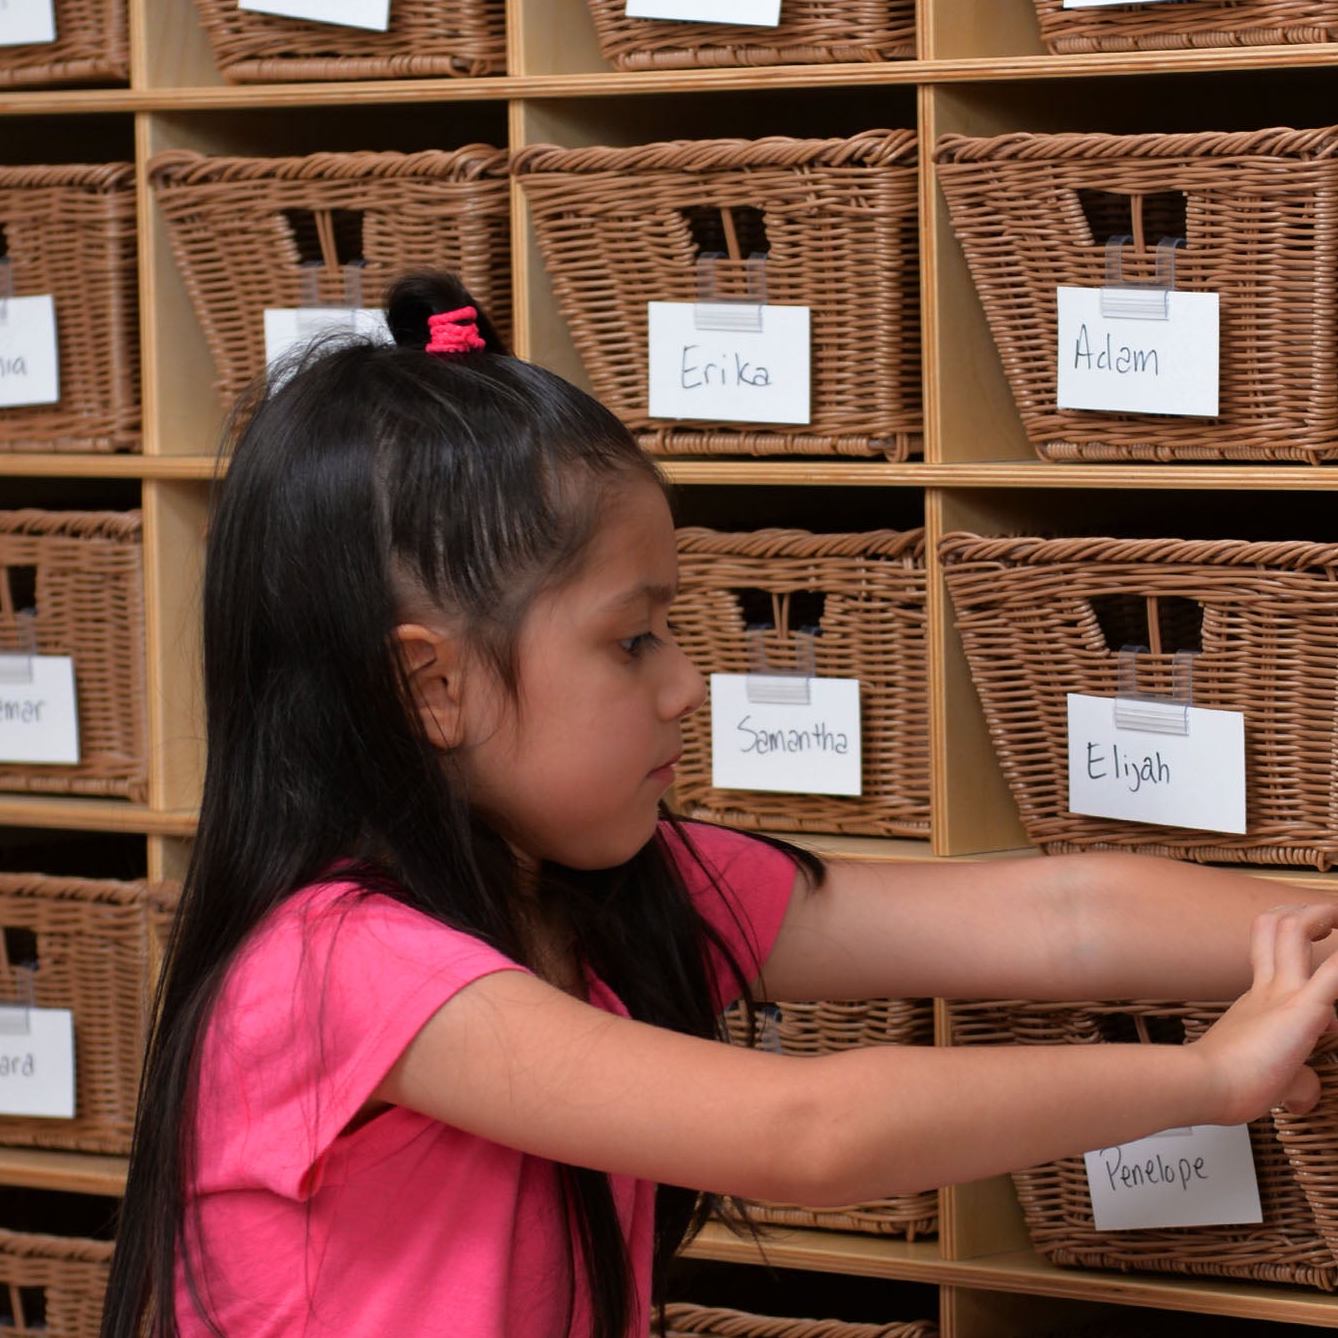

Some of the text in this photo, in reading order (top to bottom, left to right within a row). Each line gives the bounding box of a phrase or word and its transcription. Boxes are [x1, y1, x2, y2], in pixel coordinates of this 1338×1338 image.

[681, 344, 773, 390] Erika
[1074, 324, 1159, 376] Adam
[736, 714, 849, 756] Samantha
[1086, 741, 1171, 792] Elijah
[1099, 1146, 1210, 1192] Penelope
